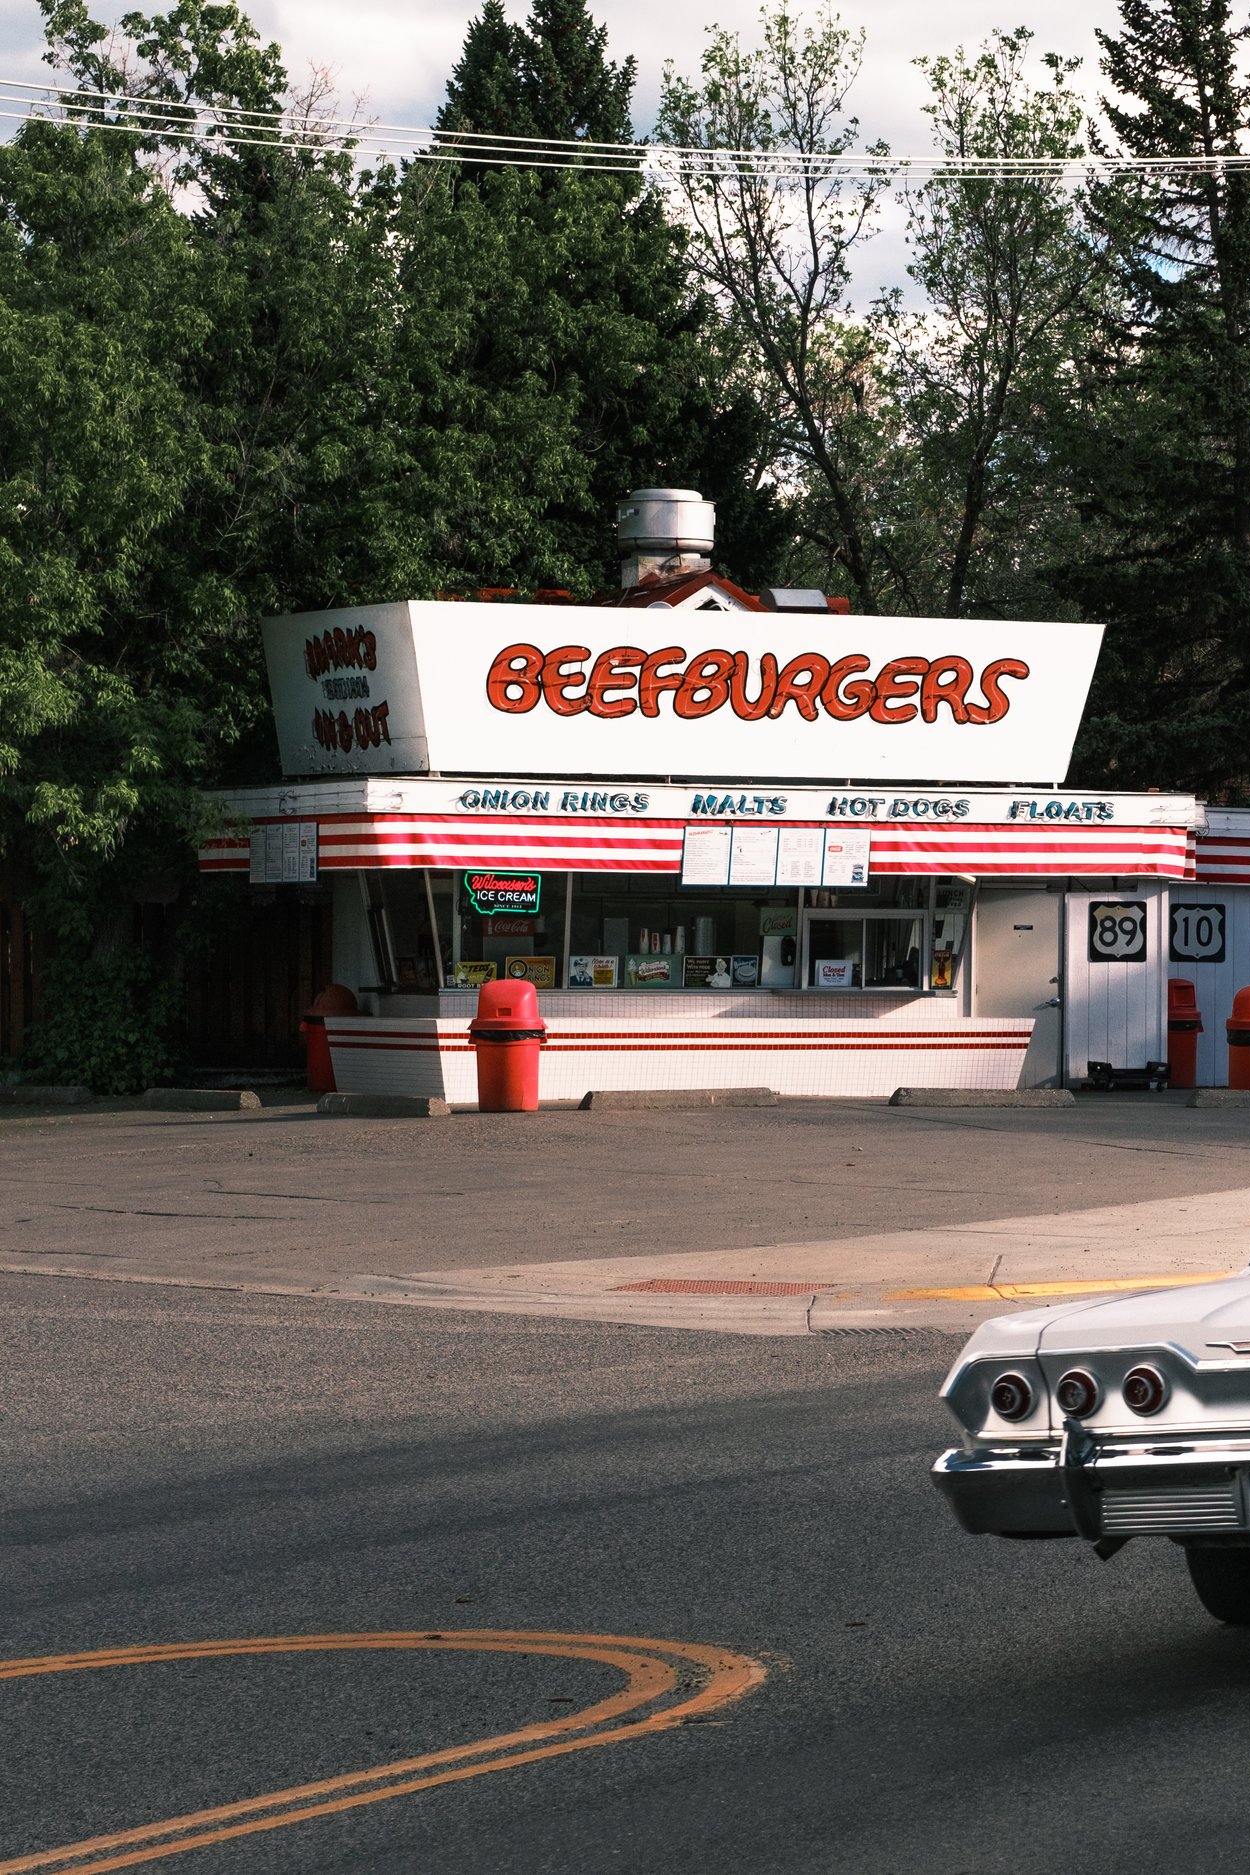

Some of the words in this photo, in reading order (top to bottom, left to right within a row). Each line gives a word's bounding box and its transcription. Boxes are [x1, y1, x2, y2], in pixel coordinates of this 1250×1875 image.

[304, 624, 377, 682] MARK'S
[486, 643, 1030, 725] BEEFBURGERS
[312, 706, 338, 752] IN
[337, 709, 353, 754] &
[353, 700, 391, 751] OUT
[458, 788, 550, 814] ONION
[560, 791, 650, 814] RINGS
[691, 793, 788, 816] MALTS
[826, 796, 885, 819] HOT
[889, 799, 971, 821] DOGS
[1008, 800, 1115, 823] FLOATS
[477, 890, 495, 901] ICE
[498, 891, 536, 902] CREAM
[495, 920, 529, 932] Coca-Cola
[763, 915, 793, 933] Closed
[1099, 915, 1138, 948] 89
[1182, 915, 1214, 947] 10
[822, 965, 846, 973] Closed
